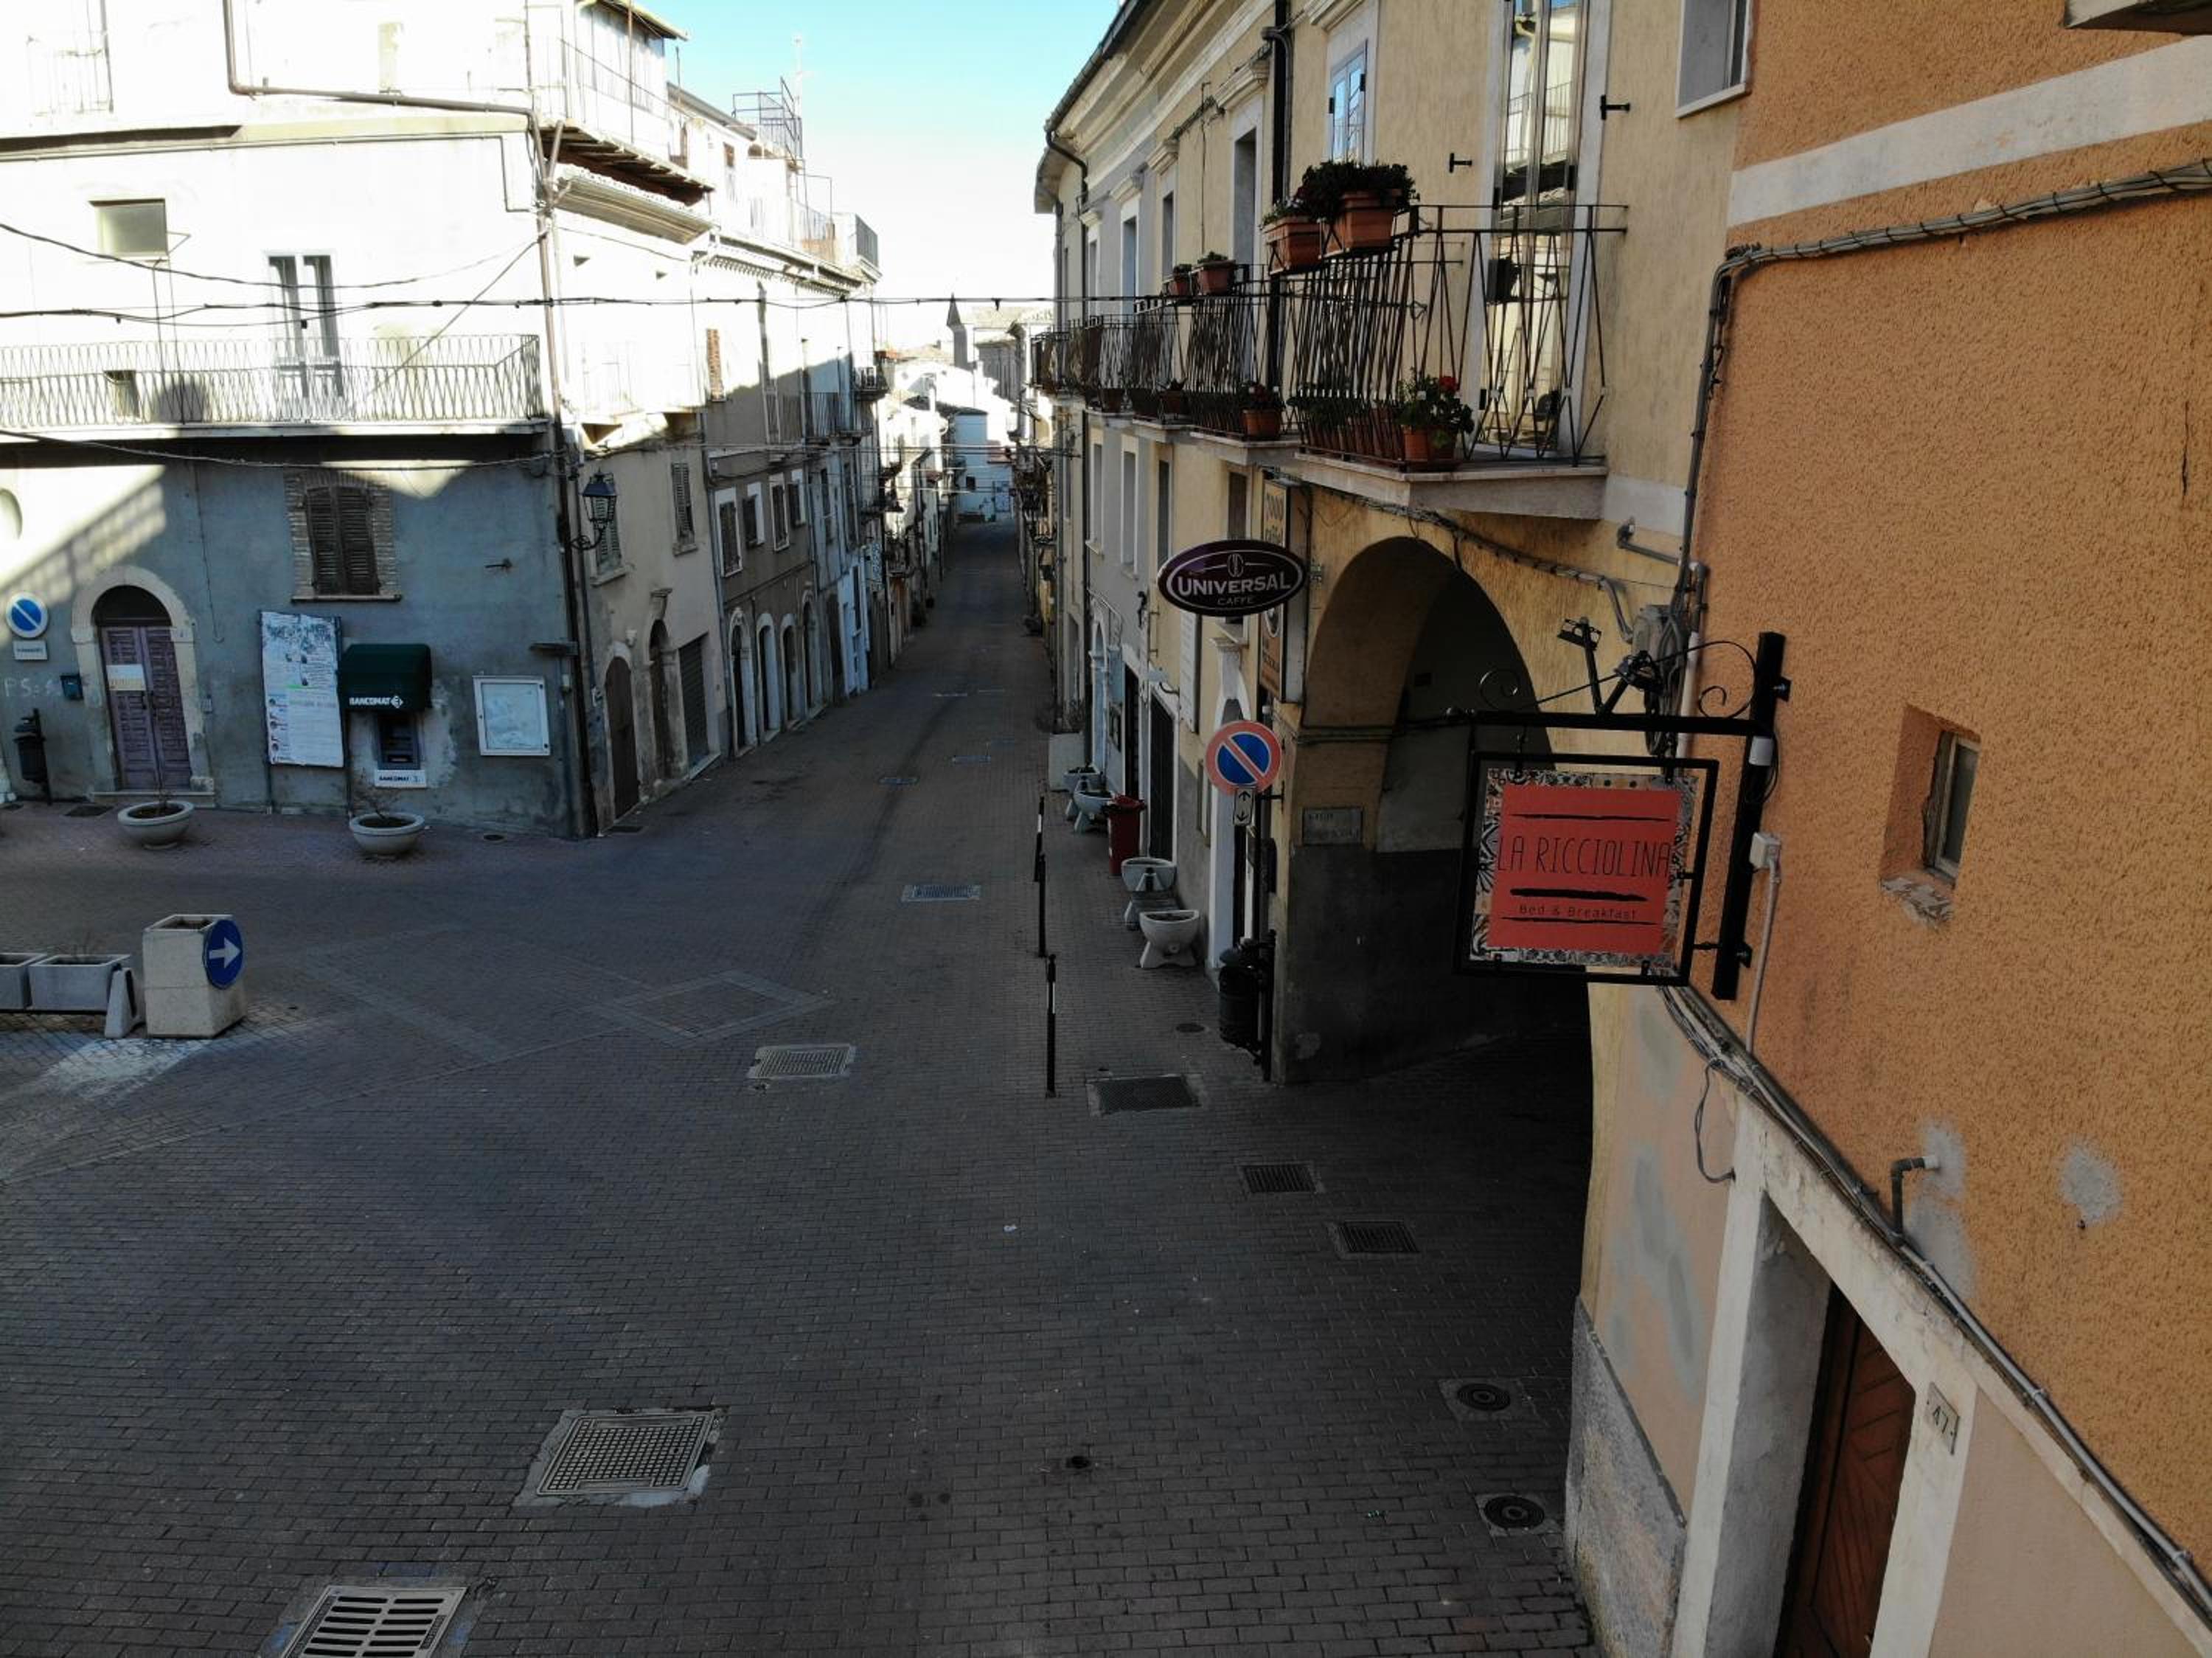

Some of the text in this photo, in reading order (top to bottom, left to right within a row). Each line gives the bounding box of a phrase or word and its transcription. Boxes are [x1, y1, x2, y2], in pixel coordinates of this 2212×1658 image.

[1178, 572, 1291, 596] UNIVERSAL
[349, 697, 391, 706] BANCOMAT
[1497, 835, 1671, 877] LA RICCIOLINA
[1519, 904, 1637, 920] Bed & Breakfast
